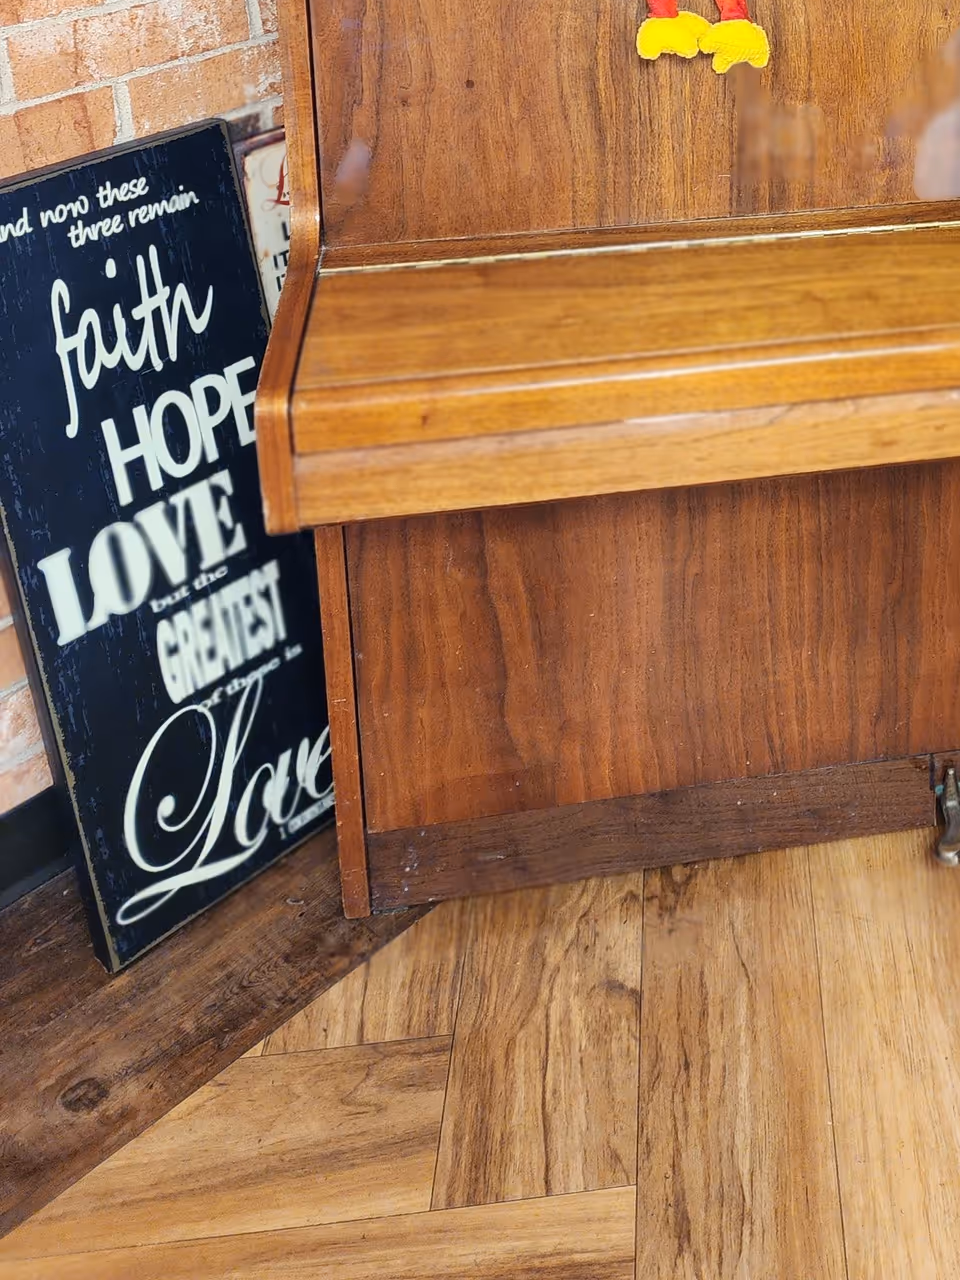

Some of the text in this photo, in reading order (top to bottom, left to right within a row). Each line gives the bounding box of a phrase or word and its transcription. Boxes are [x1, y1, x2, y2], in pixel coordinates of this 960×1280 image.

[40, 195, 89, 228] now
[96, 176, 149, 208] these
[67, 185, 200, 248] three remain
[51, 243, 213, 438] faith
[101, 356, 258, 506] HOPE
[37, 470, 247, 646] LOVE
[149, 566, 228, 613] but the
[157, 559, 286, 704] GREATEST
[197, 686, 224, 712] of
[116, 675, 334, 926] Love
